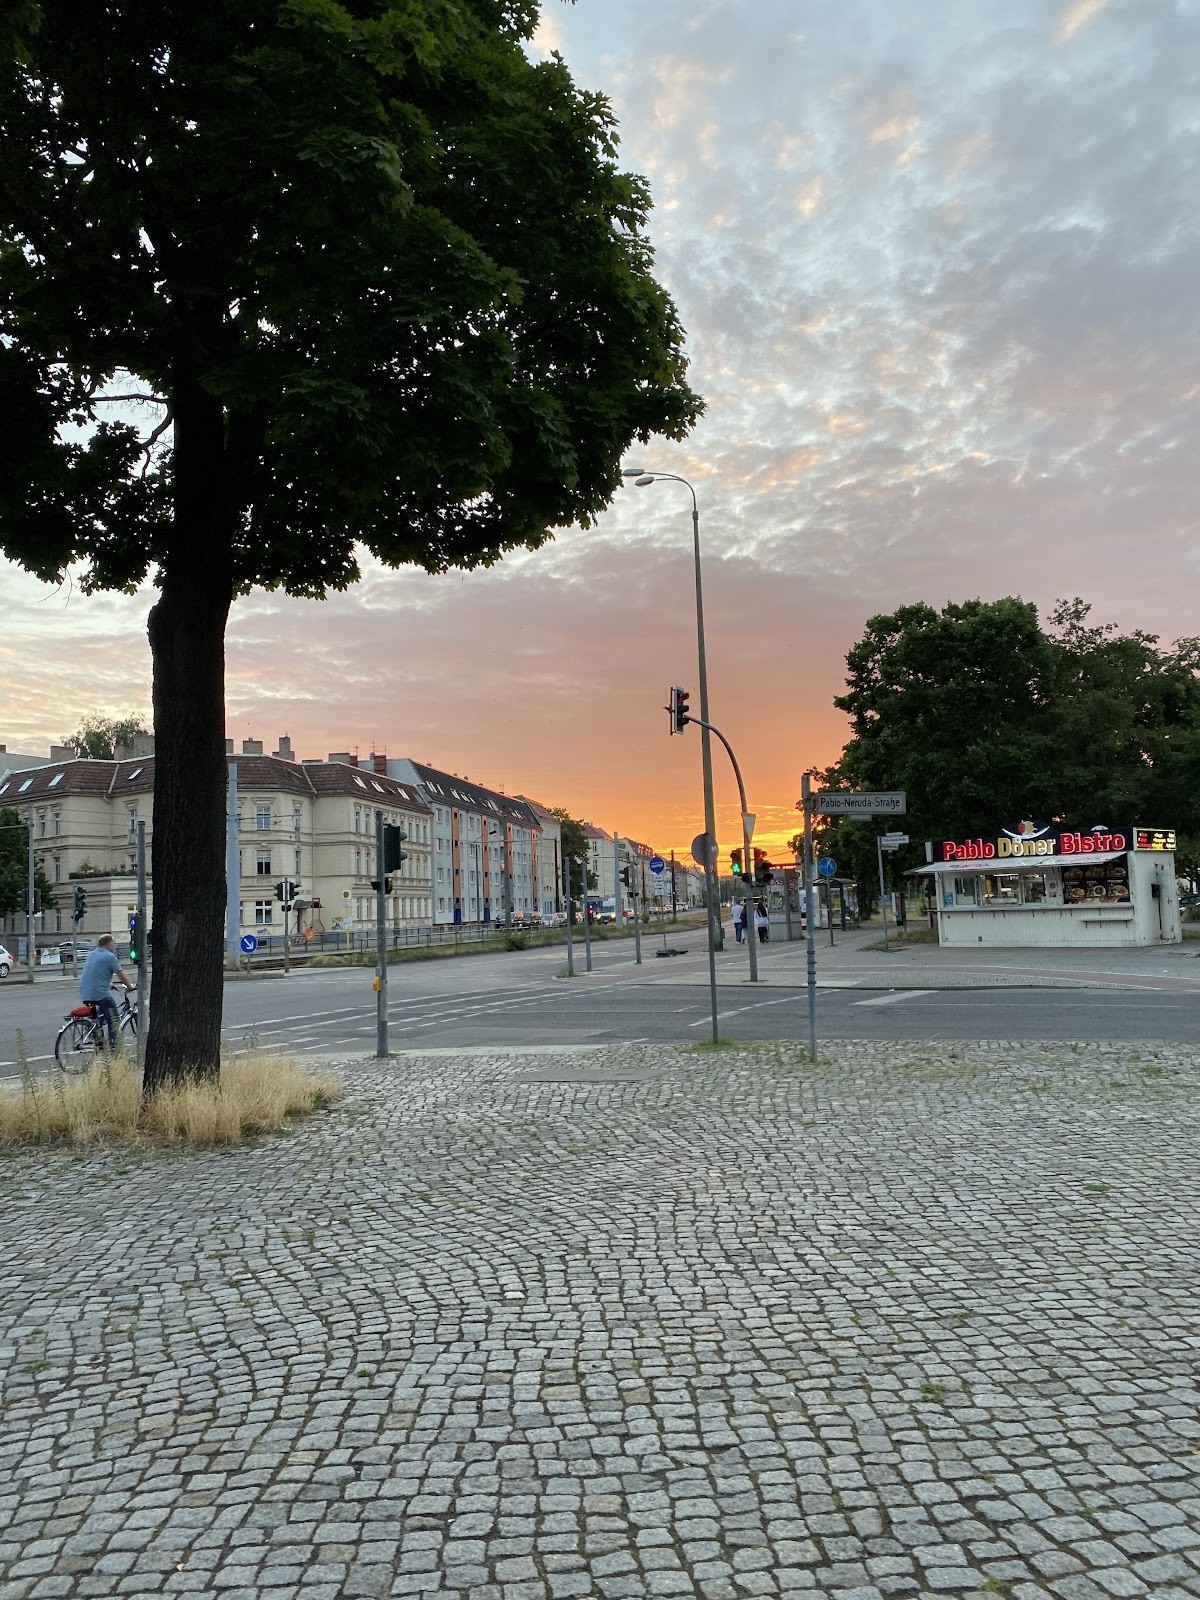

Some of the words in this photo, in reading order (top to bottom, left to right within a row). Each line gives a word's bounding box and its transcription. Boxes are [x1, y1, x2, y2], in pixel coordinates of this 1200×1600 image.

[820, 797, 900, 809] Pablo-Neruda-Straße
[943, 838, 994, 860] Pablo
[997, 837, 1056, 857] Döner
[1059, 832, 1126, 854] Bistro
